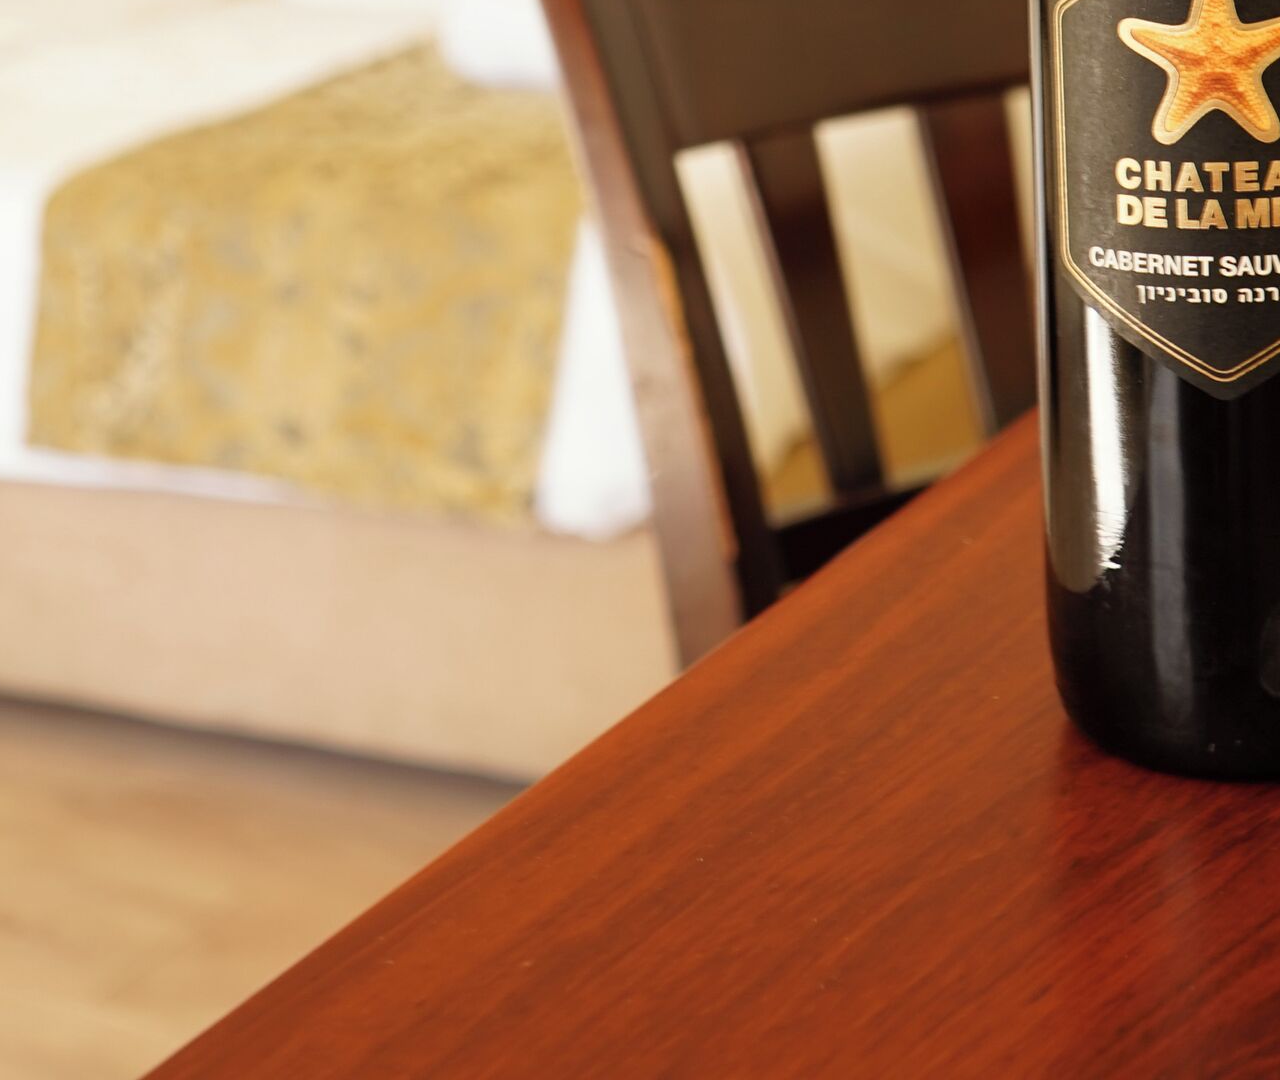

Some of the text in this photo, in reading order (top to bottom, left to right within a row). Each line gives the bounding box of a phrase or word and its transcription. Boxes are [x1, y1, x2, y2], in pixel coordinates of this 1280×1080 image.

[1116, 194, 1169, 228] DE
[1175, 198, 1229, 229] LA
[1088, 245, 1215, 277] CABERNET
[1136, 284, 1228, 305] סוביניון
